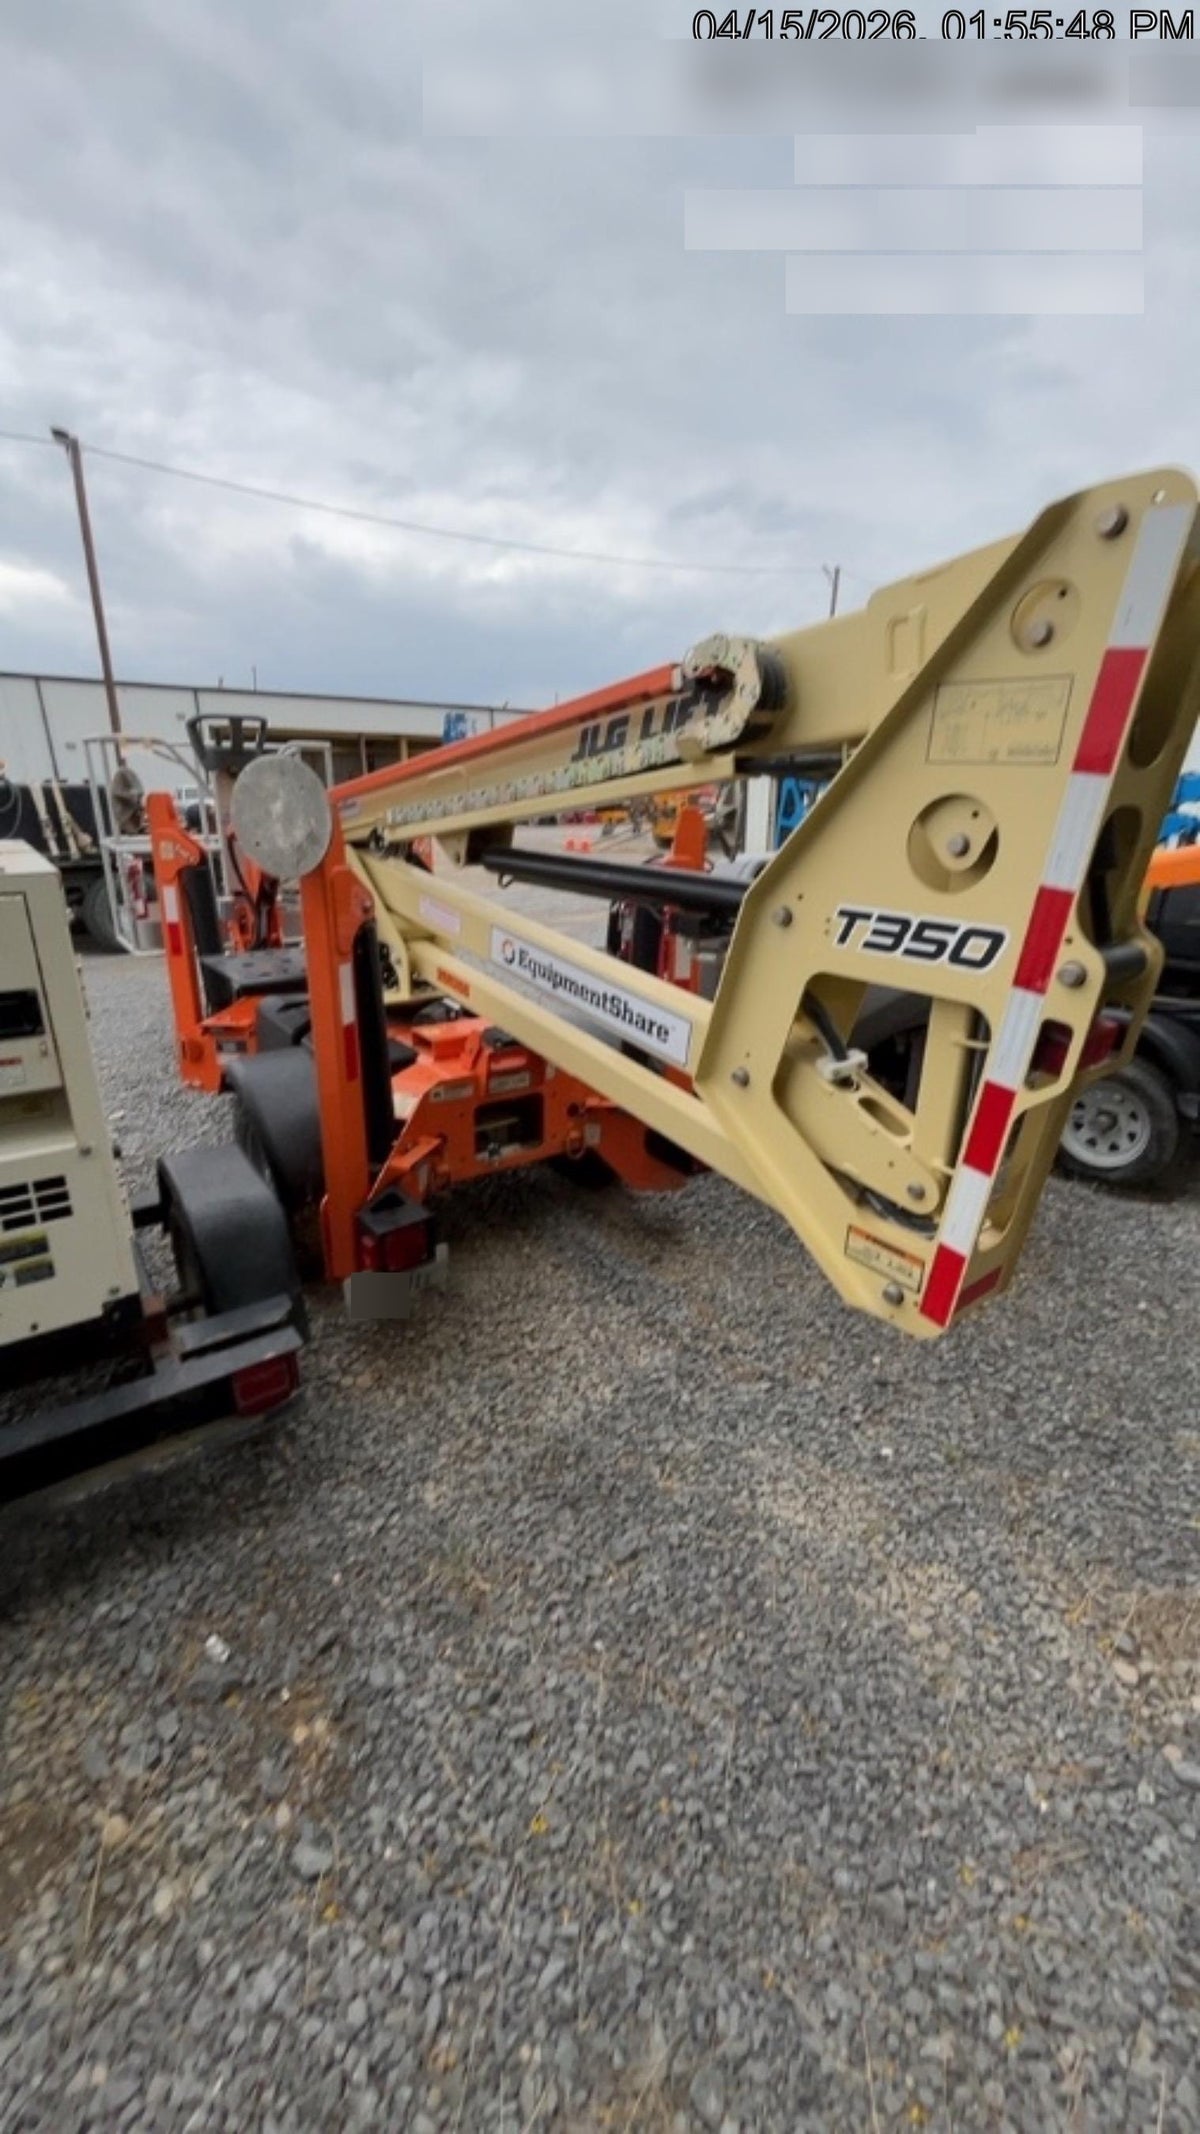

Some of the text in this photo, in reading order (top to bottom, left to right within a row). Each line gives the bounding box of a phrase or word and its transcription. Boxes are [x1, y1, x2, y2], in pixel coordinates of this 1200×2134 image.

[571, 714, 631, 763] JLG
[837, 909, 1006, 969] T350
[518, 948, 670, 1044] EquipmentShare
